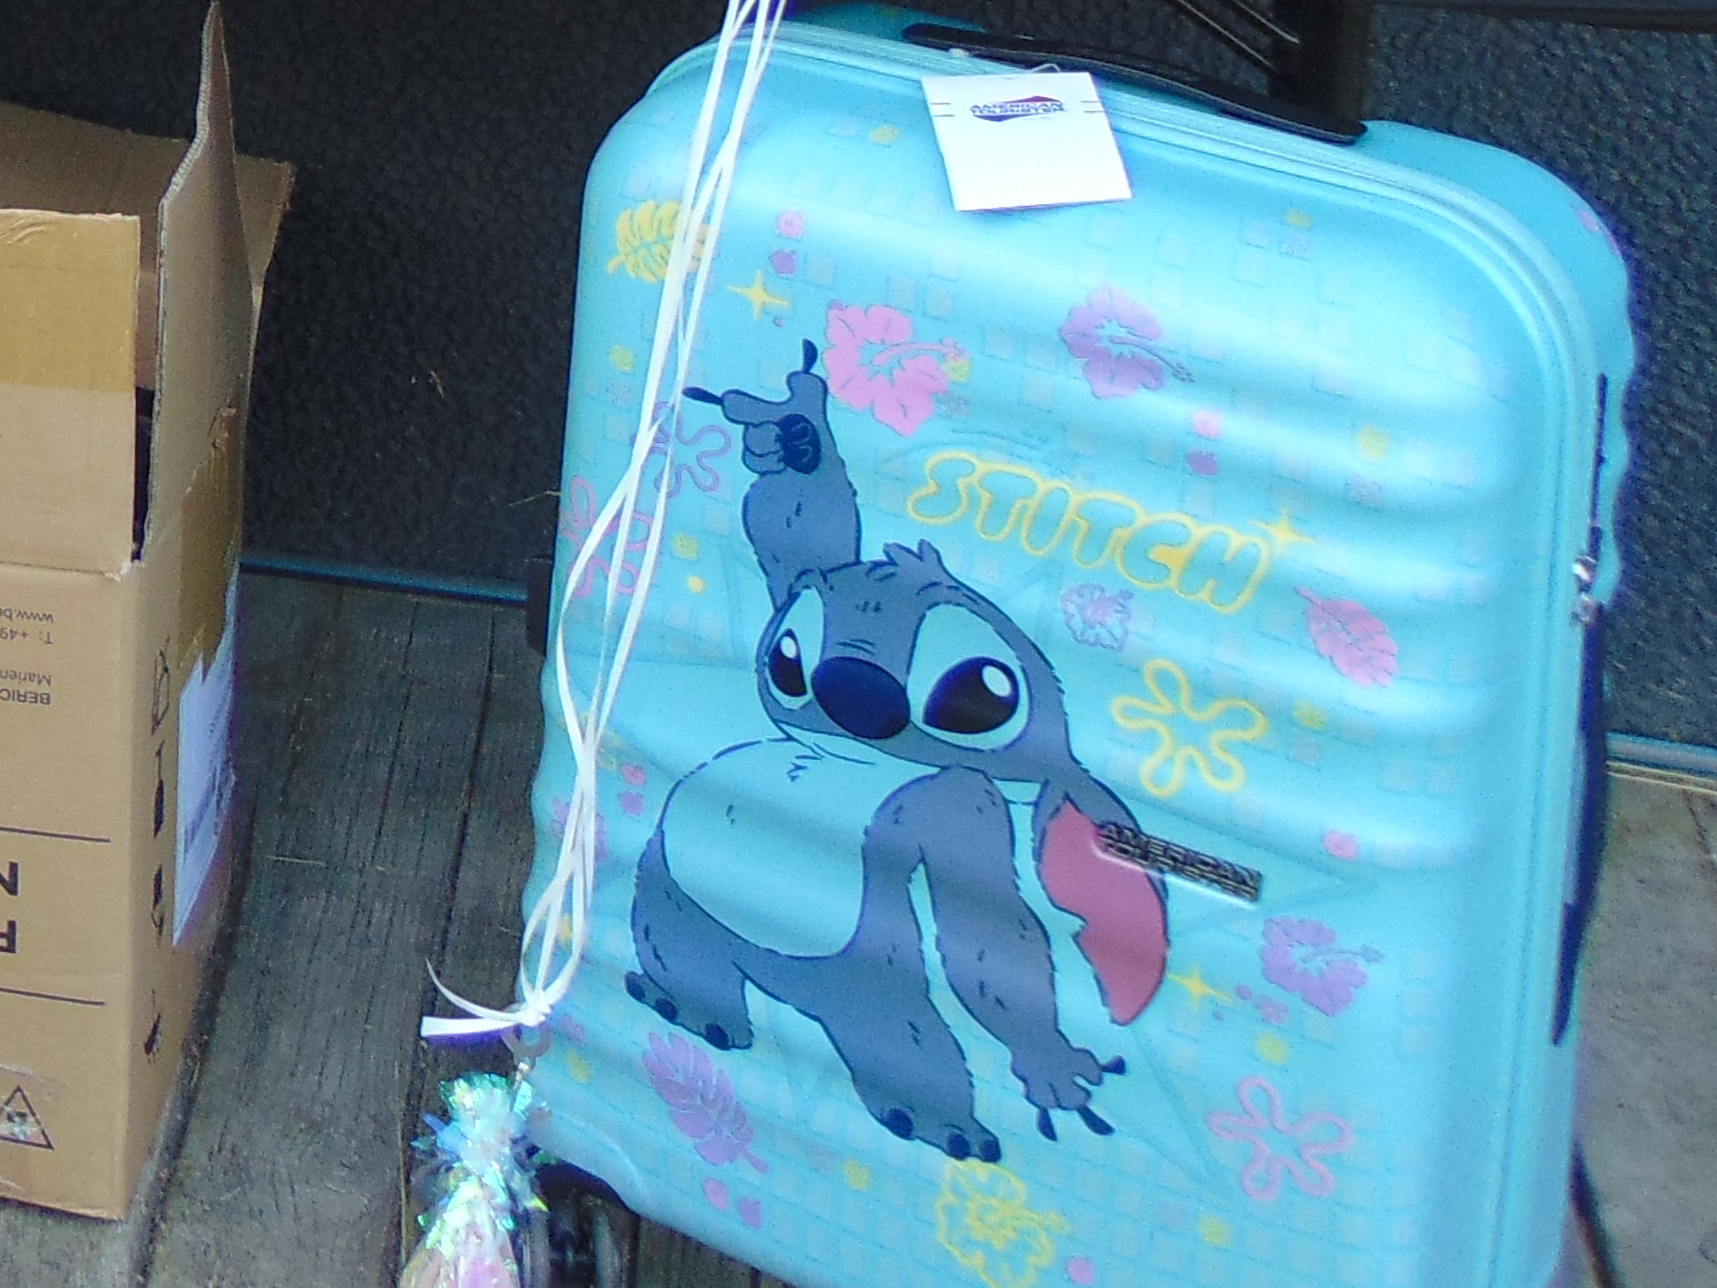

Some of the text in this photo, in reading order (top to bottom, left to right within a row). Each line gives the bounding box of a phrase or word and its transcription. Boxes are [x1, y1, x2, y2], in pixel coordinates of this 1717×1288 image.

[906, 451, 1270, 615] STITCH
[0, 626, 29, 641] +49
[38, 630, 54, 645] T:
